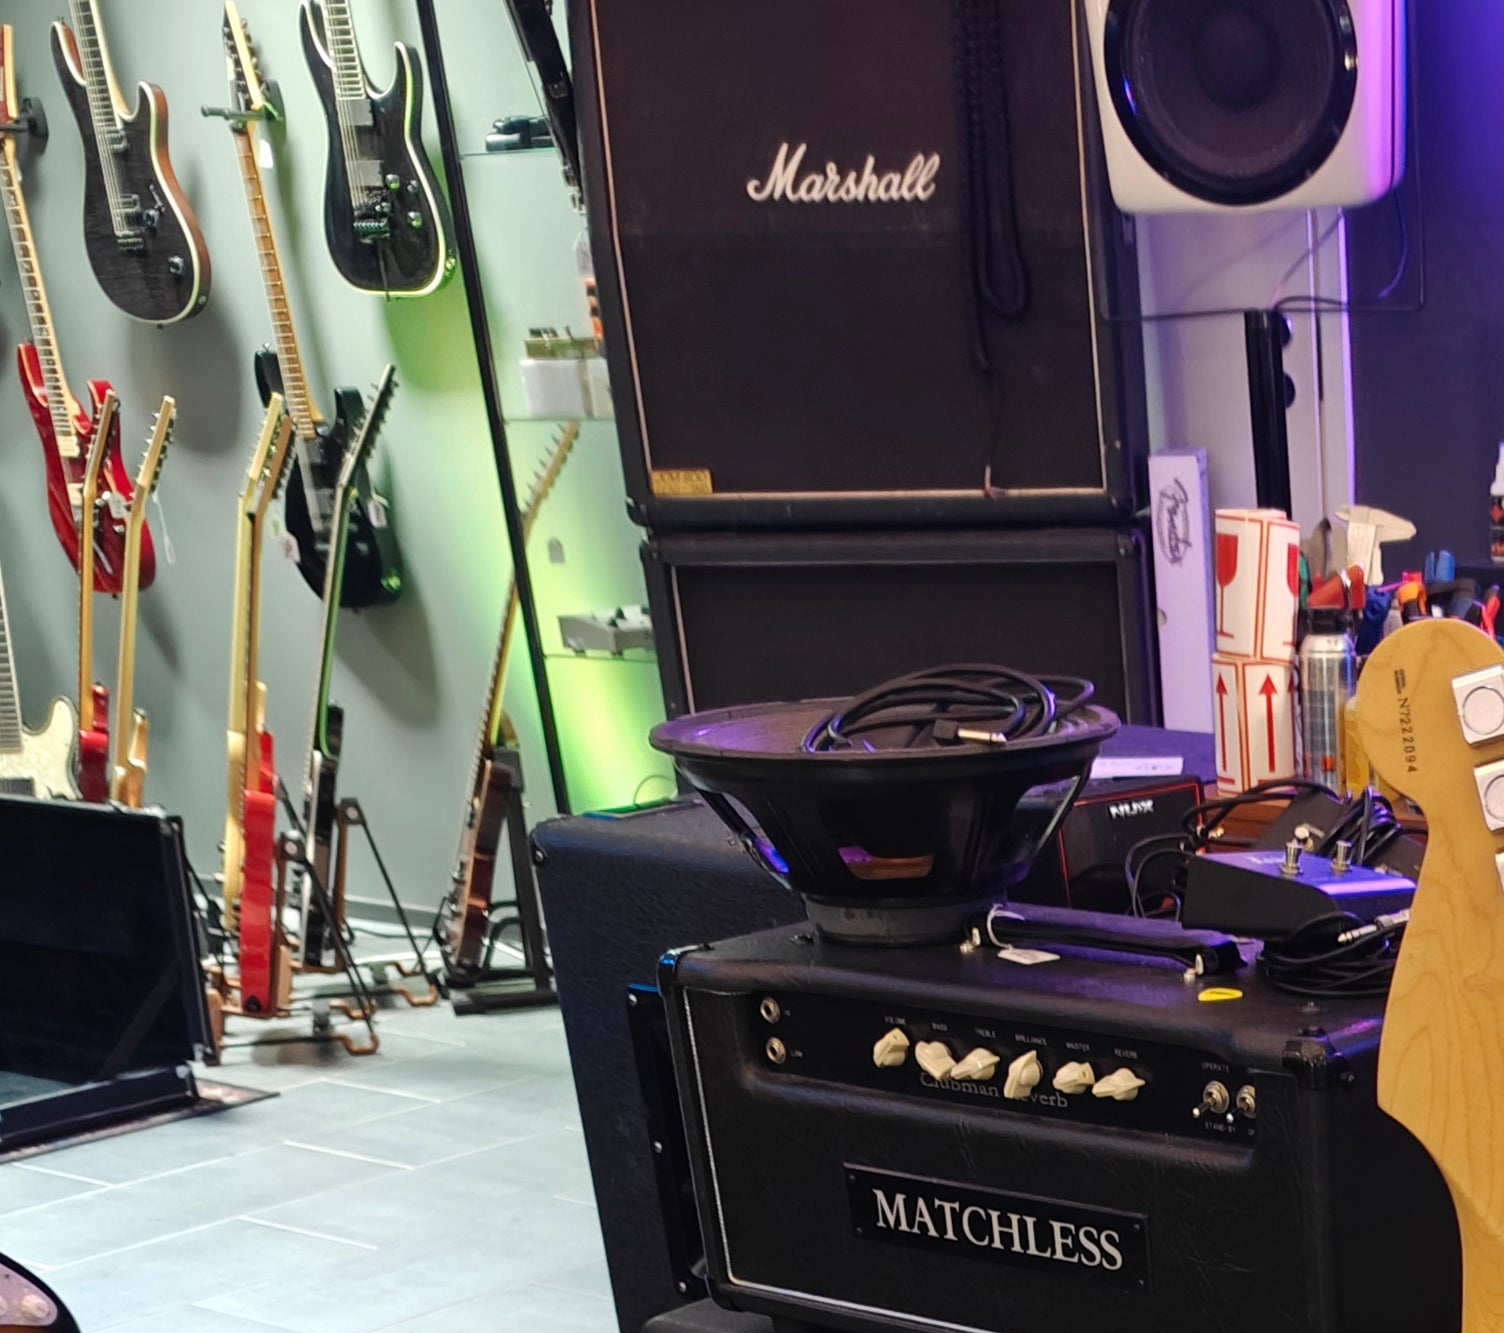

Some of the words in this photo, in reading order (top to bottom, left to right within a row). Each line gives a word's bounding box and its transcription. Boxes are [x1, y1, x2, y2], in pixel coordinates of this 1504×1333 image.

[747, 142, 940, 202] Marshall
[1398, 696, 1418, 773] N7222094
[872, 1188, 1123, 1271] MATCHLESS
